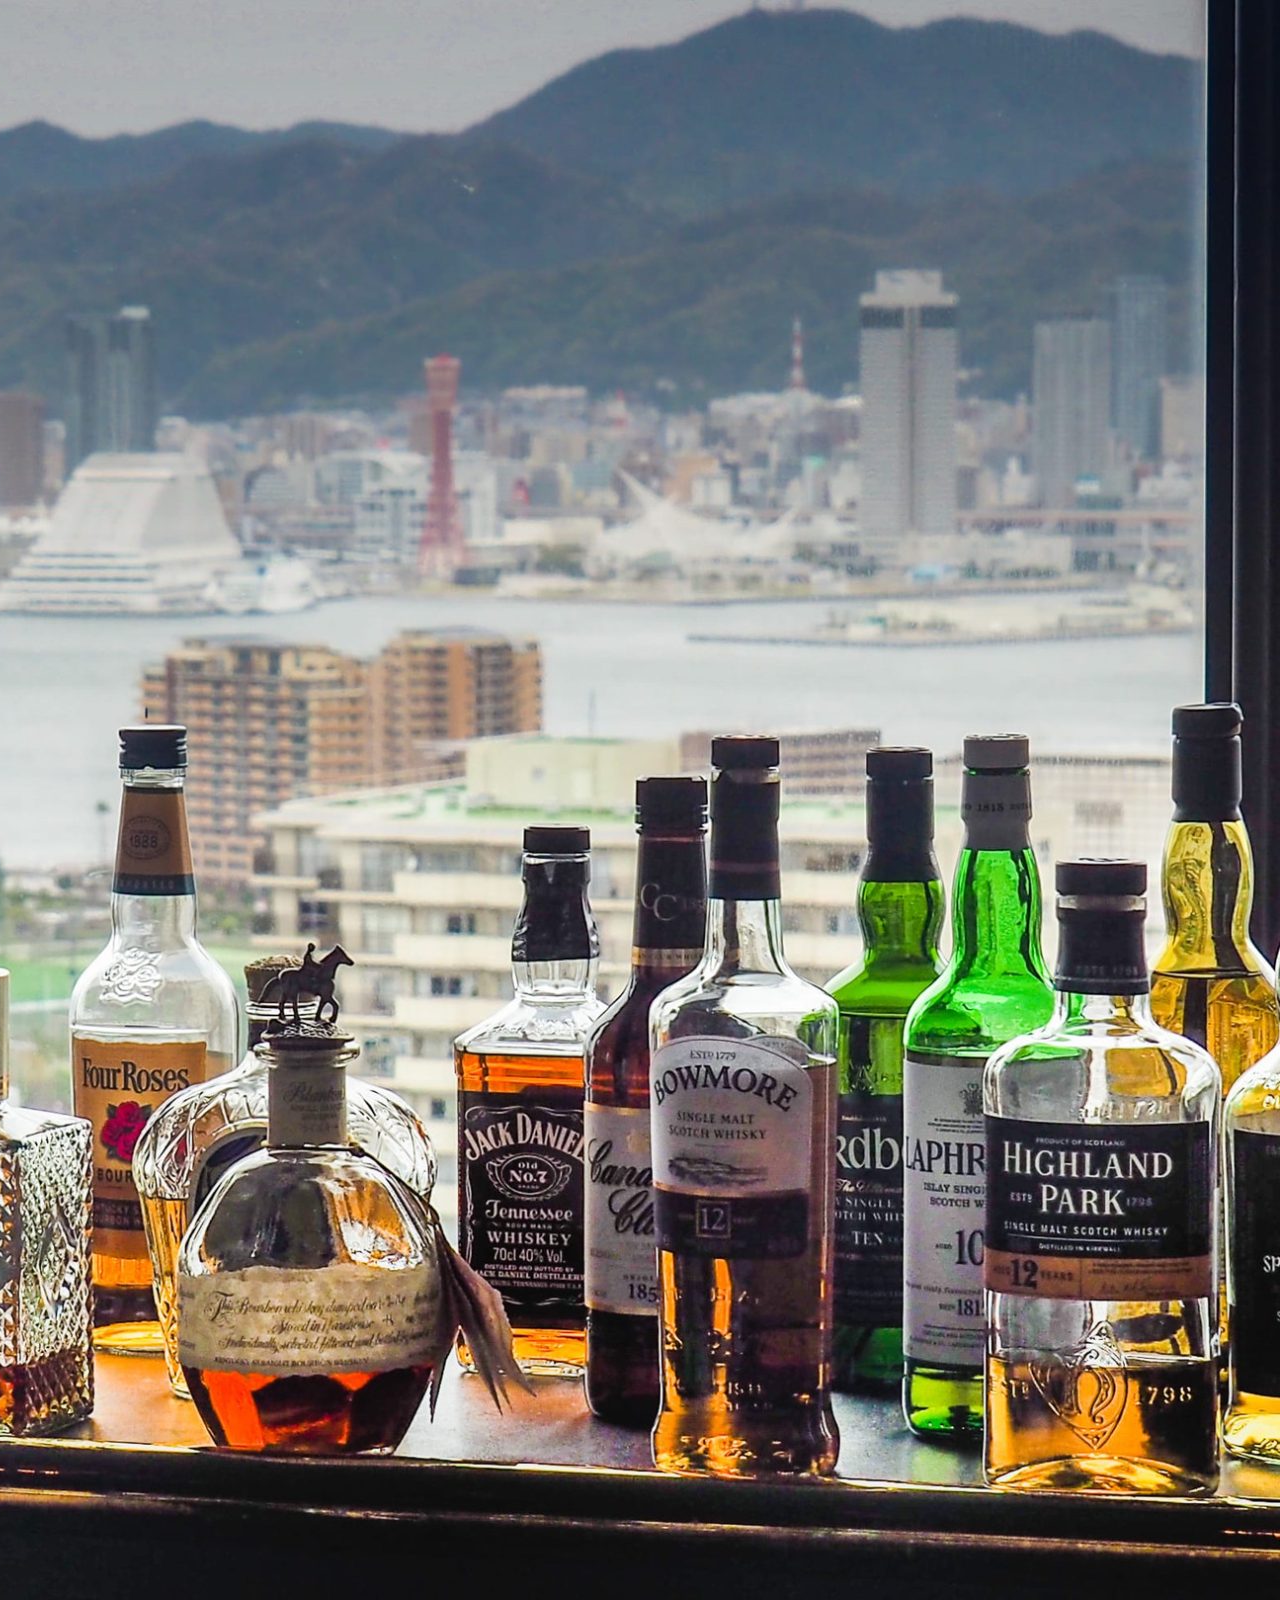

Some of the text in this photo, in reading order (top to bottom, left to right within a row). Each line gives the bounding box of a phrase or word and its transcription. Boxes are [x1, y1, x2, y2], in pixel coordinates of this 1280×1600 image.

[715, 1052, 736, 1061] 1779
[82, 1058, 189, 1093] Four Roses
[654, 1064, 798, 1112] BOWMORE
[677, 1111, 755, 1125] SINGLE MALT
[669, 1125, 767, 1140] SCOTCH WHISKY
[464, 1122, 514, 1161] JACK
[1036, 1138, 1070, 1146] PRODUCT
[906, 1136, 985, 1175] LAPHR
[1003, 1141, 1173, 1178] HIGHLAND
[924, 1182, 950, 1193] ISLAY
[845, 1197, 895, 1208] SINGLE
[930, 1197, 970, 1207] SCOTCH
[1040, 1184, 1126, 1216] PARK
[1126, 1197, 1153, 1207] 1798
[485, 1200, 573, 1222] Tennessee
[701, 1208, 724, 1230] 12
[1004, 1221, 1168, 1236] SINGLE MALT SCOTCH WHISKY
[487, 1231, 572, 1246] WHISKEY
[852, 1231, 883, 1246] TEN
[955, 1230, 984, 1265] 10
[493, 1248, 566, 1263] 70cl 40% Vol.
[498, 1271, 531, 1279] DANIEL
[1010, 1259, 1038, 1290] 12
